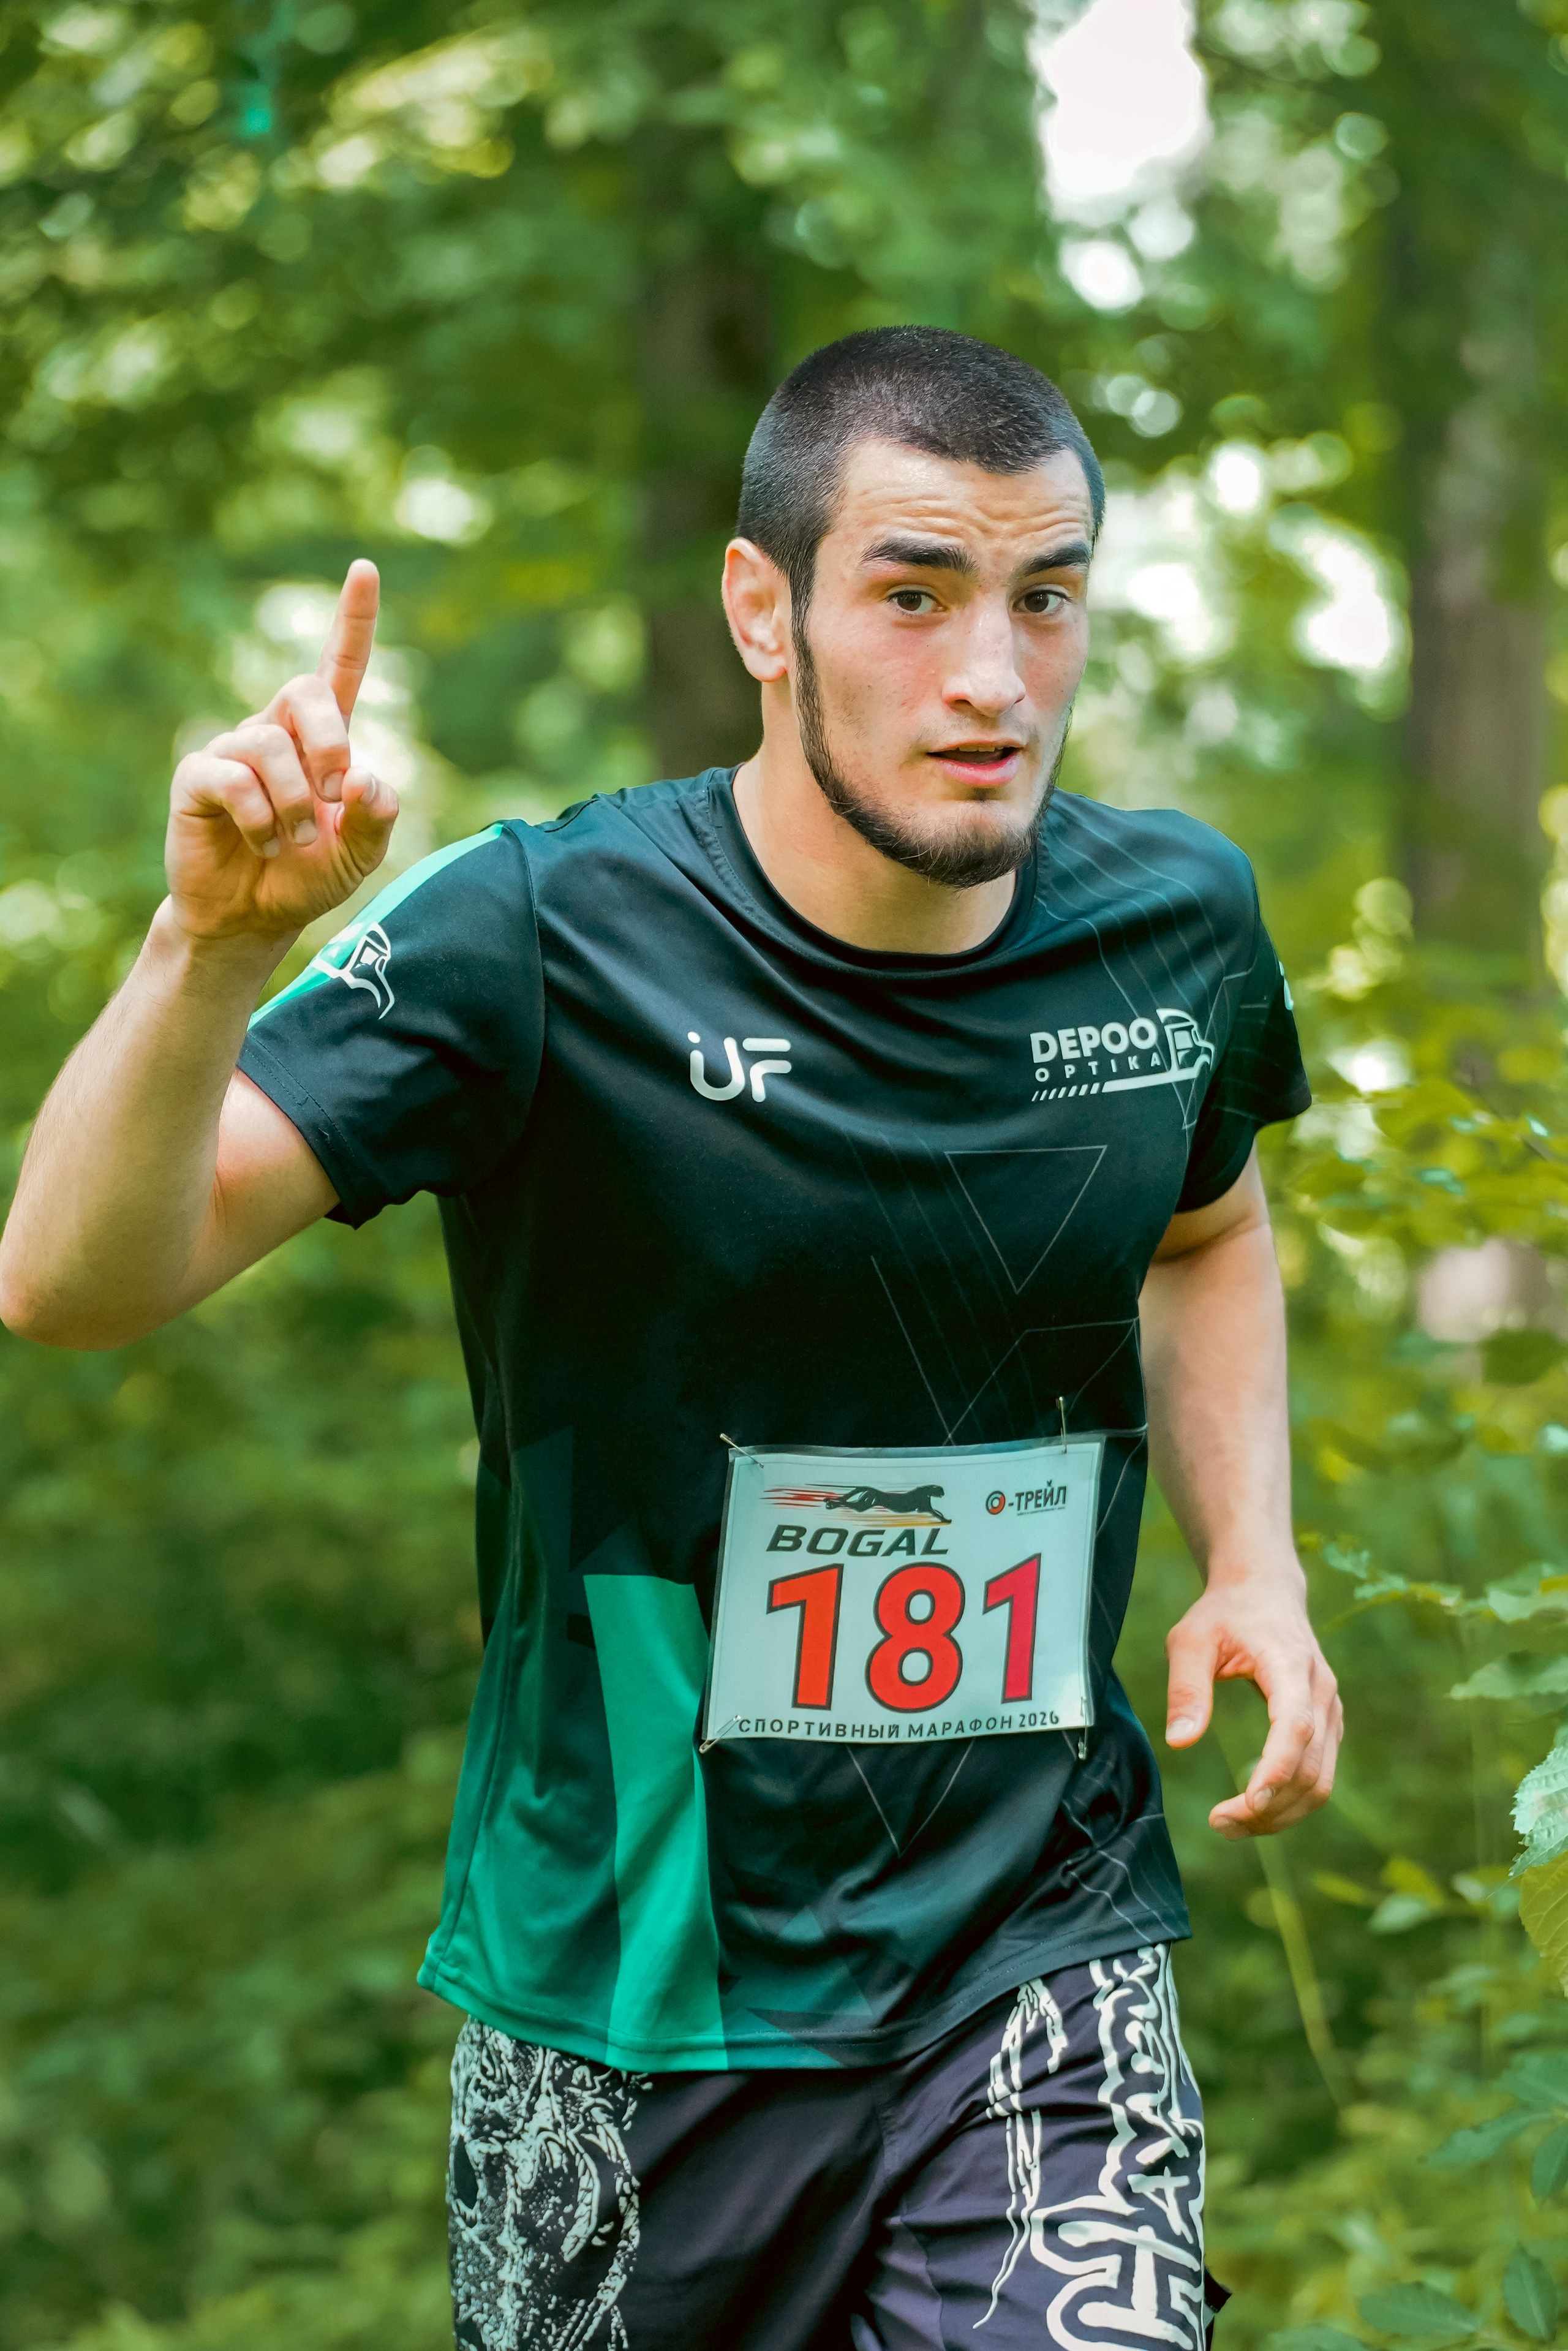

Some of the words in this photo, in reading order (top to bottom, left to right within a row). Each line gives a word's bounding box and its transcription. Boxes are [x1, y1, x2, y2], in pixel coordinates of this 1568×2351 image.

[1030, 1017, 1158, 1063] DEPOO
[1035, 1052, 1162, 1082] OPTIKA
[766, 1524, 952, 1557] BOGAL
[766, 1552, 1042, 1714] 181
[738, 1718, 900, 1739] СПОРТИВНЫЙ
[908, 1715, 1012, 1738] МАРАФОН
[1018, 1710, 1060, 1728] 2026
